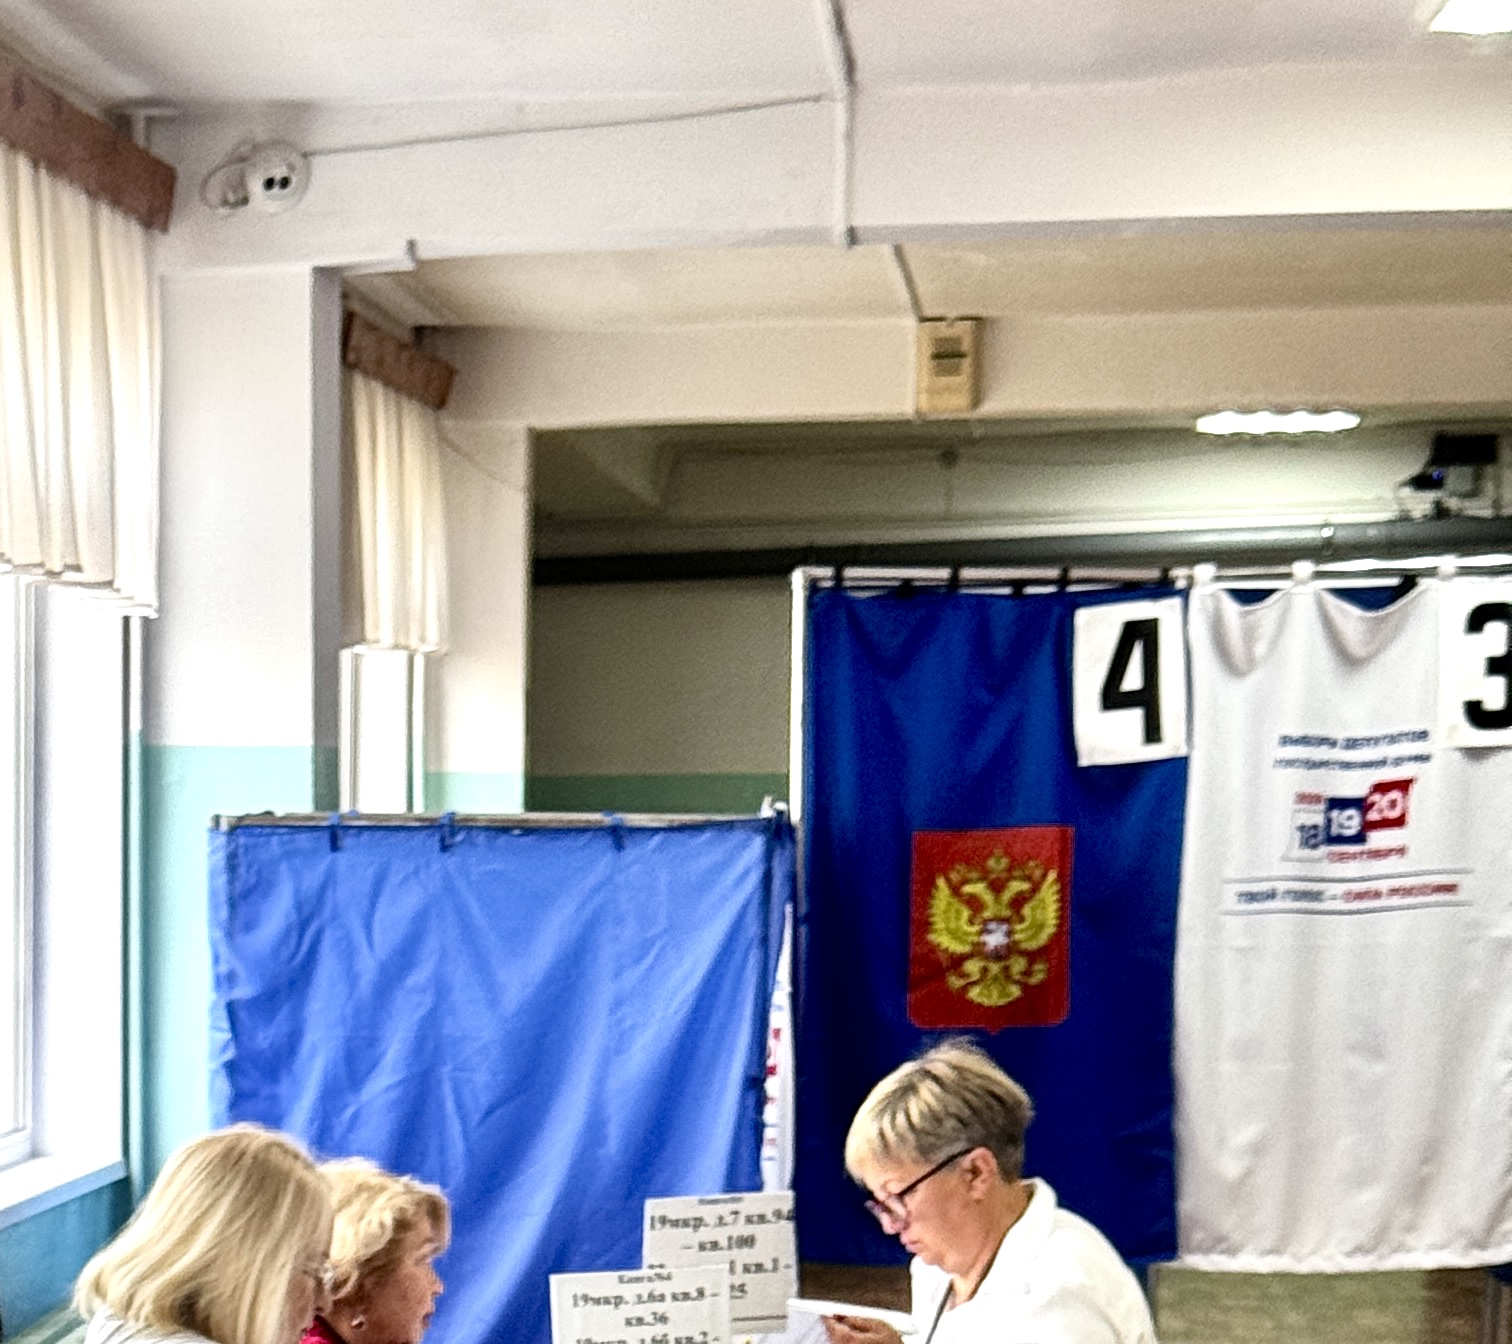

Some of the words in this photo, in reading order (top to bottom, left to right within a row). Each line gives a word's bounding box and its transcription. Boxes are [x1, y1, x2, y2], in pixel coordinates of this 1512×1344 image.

[1100, 617, 1163, 745] 4
[1463, 601, 1512, 730] 3
[1329, 807, 1362, 837] 19
[1364, 788, 1406, 821] 20
